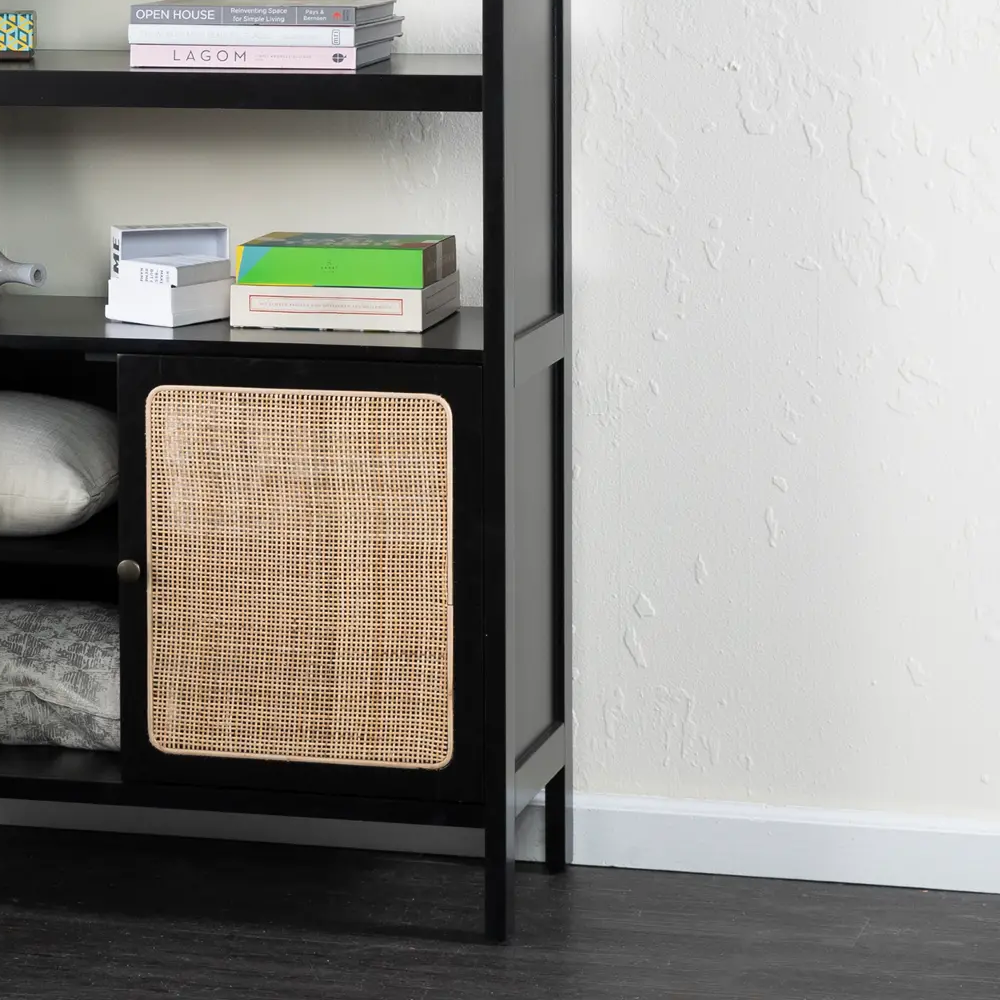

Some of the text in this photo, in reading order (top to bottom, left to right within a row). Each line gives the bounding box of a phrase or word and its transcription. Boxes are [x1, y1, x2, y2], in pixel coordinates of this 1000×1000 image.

[136, 9, 215, 20] OPEN HOUSE
[230, 7, 288, 16] Reinventing Space
[243, 16, 265, 24] Simple
[266, 16, 285, 24] Living
[173, 49, 247, 62] LAGOM
